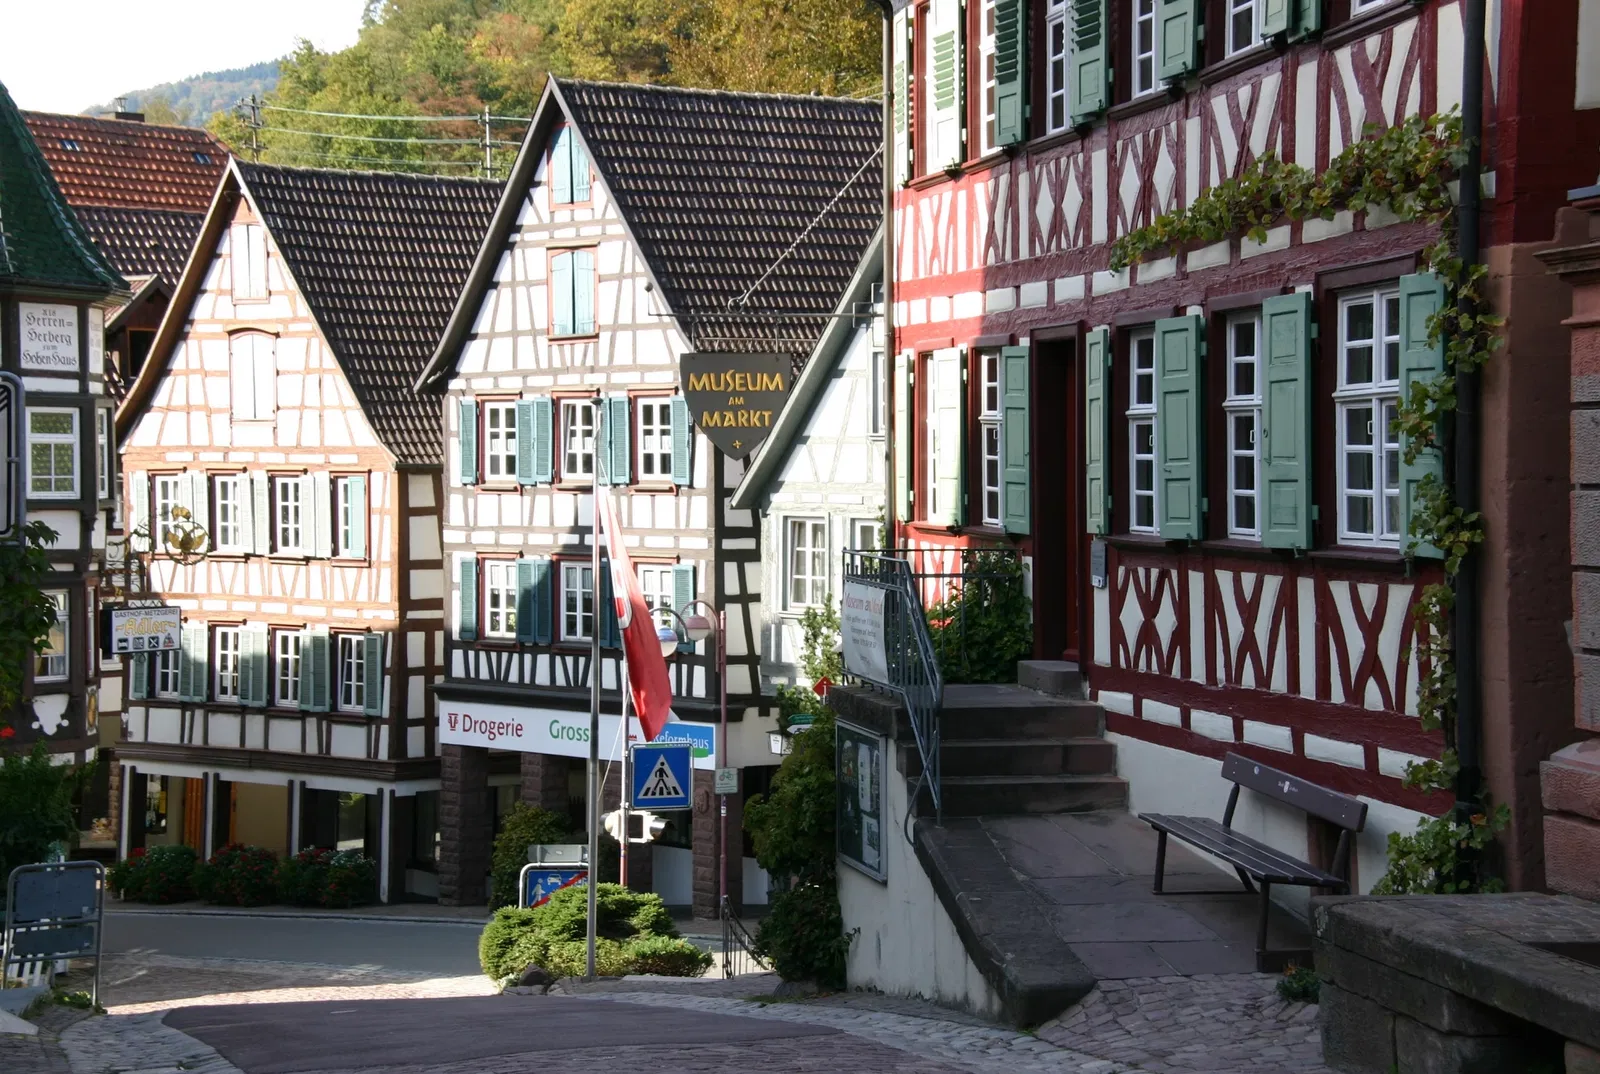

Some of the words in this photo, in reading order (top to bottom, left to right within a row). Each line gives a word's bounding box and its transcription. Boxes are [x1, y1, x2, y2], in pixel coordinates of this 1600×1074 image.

[27, 328, 72, 346] Herberg
[688, 369, 784, 392] MUSEUM
[728, 397, 744, 406] AM
[702, 409, 772, 428] MARKT
[462, 714, 523, 741] Drogerie
[549, 719, 590, 742] Gross
